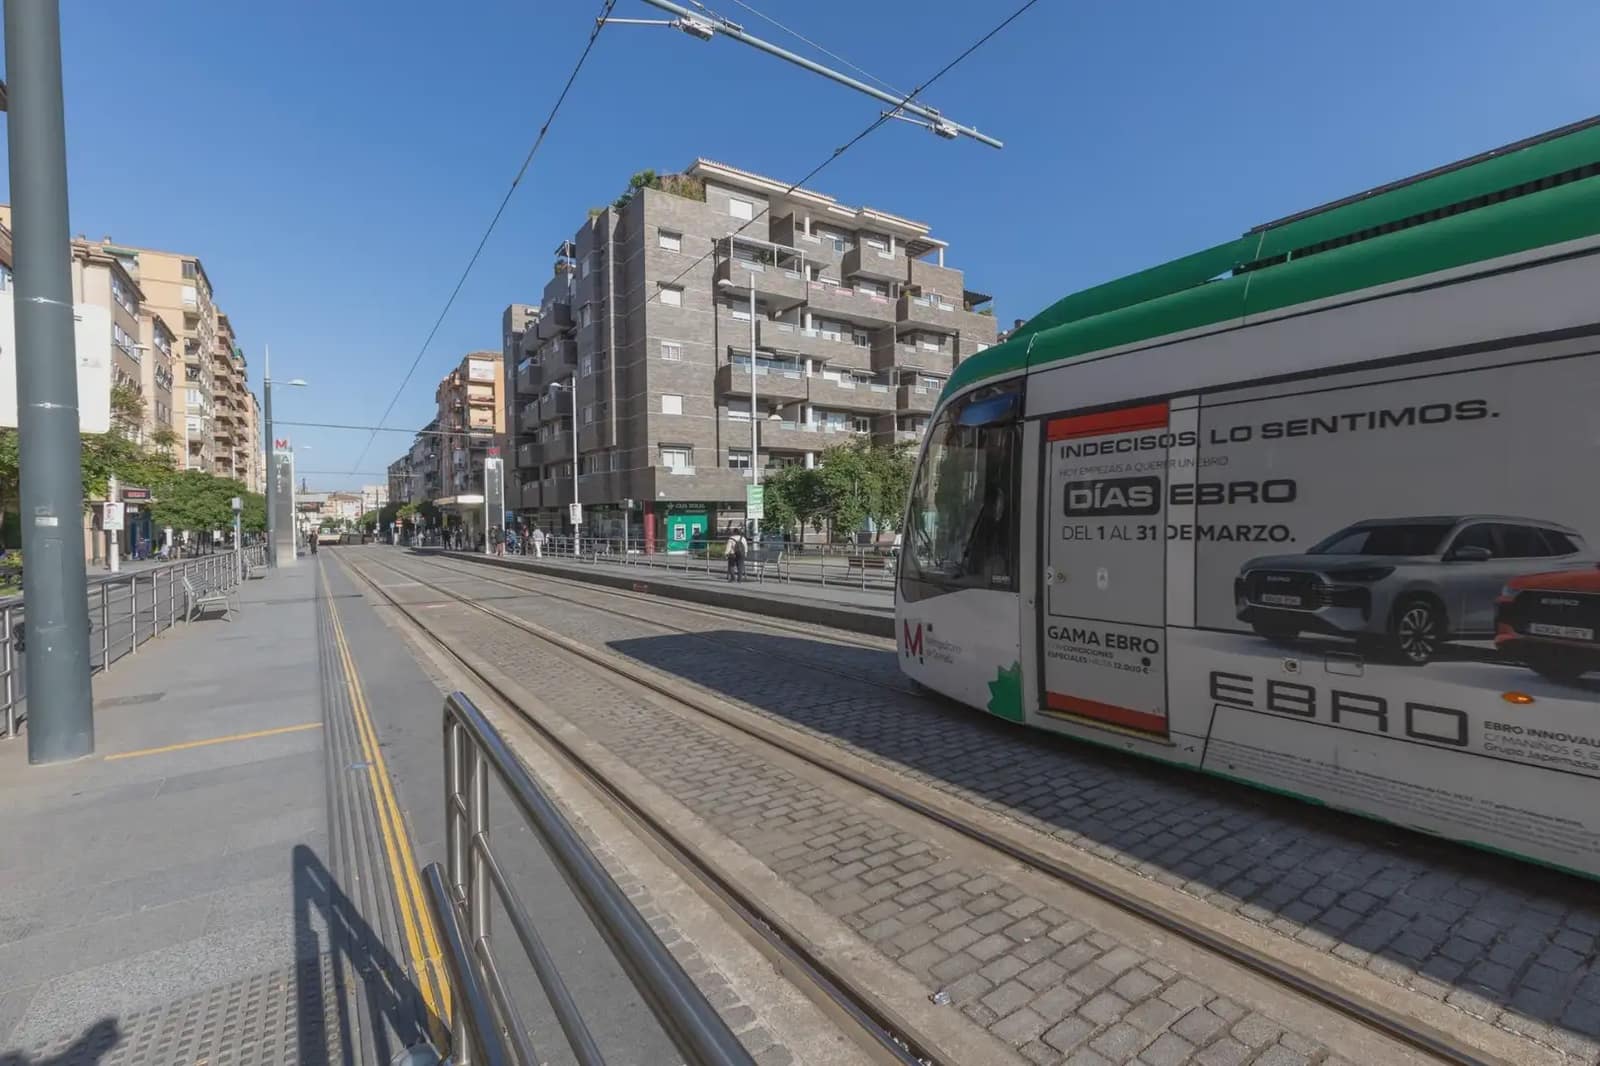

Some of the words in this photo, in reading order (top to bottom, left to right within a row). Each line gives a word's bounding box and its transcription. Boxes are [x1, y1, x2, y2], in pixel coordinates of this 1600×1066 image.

[1210, 425, 1252, 445] LO
[1261, 399, 1500, 440] SENTIMOS.
[1125, 462, 1133, 472] A
[1178, 458, 1195, 469] UN
[1069, 482, 1154, 510] DÍAS
[1169, 479, 1297, 505] EBRO
[1062, 525, 1092, 541] DEL
[1097, 525, 1105, 541] 1
[1110, 525, 1132, 541] AL
[1136, 524, 1157, 541] 31
[1167, 524, 1193, 541] DE
[1197, 524, 1296, 543] MARZO.
[903, 618, 924, 665] M
[1047, 625, 1101, 647] GAMA
[1105, 632, 1159, 655] EBRO
[1209, 669, 1470, 747] EBRO
[1483, 720, 1524, 735] EBRO
